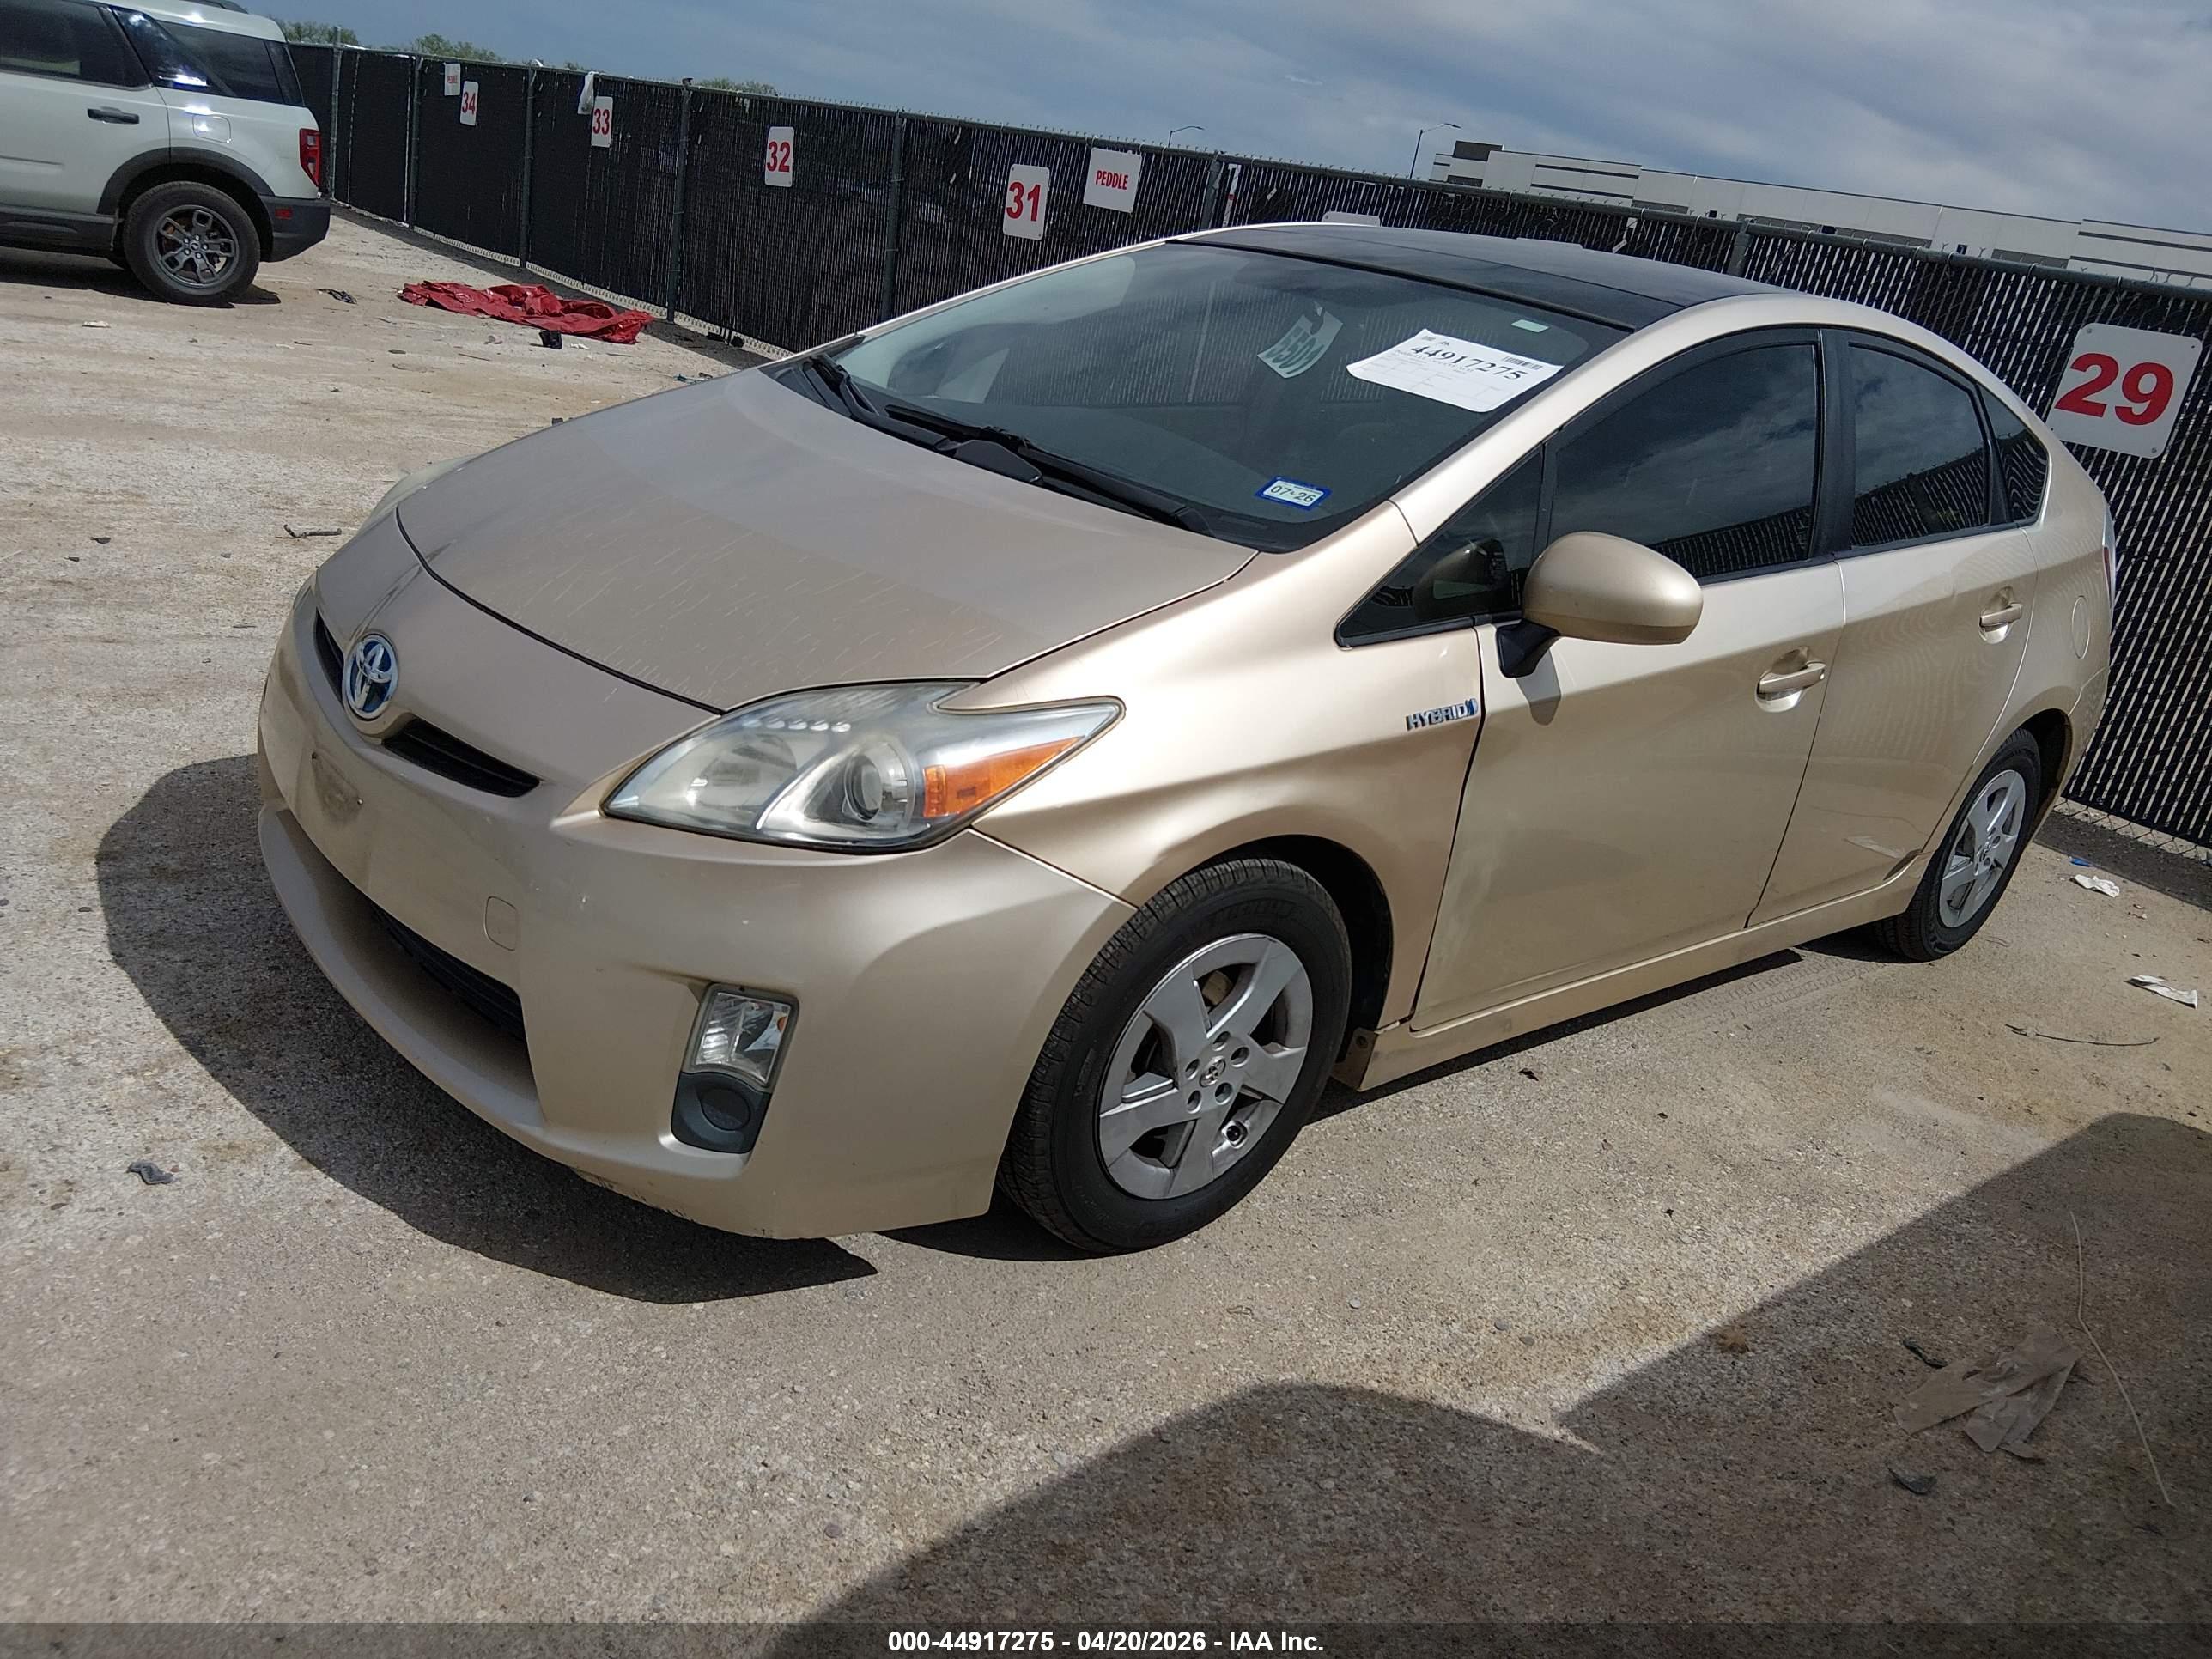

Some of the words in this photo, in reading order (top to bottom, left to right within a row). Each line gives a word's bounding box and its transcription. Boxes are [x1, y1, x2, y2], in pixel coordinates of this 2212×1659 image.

[462, 91, 476, 115] 34
[592, 108, 611, 135] 33
[766, 141, 791, 173] 32
[1095, 169, 1129, 191] PEDDLE
[1006, 181, 1042, 222] 31
[1411, 345, 1528, 380] 44917275
[2053, 352, 2174, 426] 29
[1406, 702, 1468, 732] HYBRID
